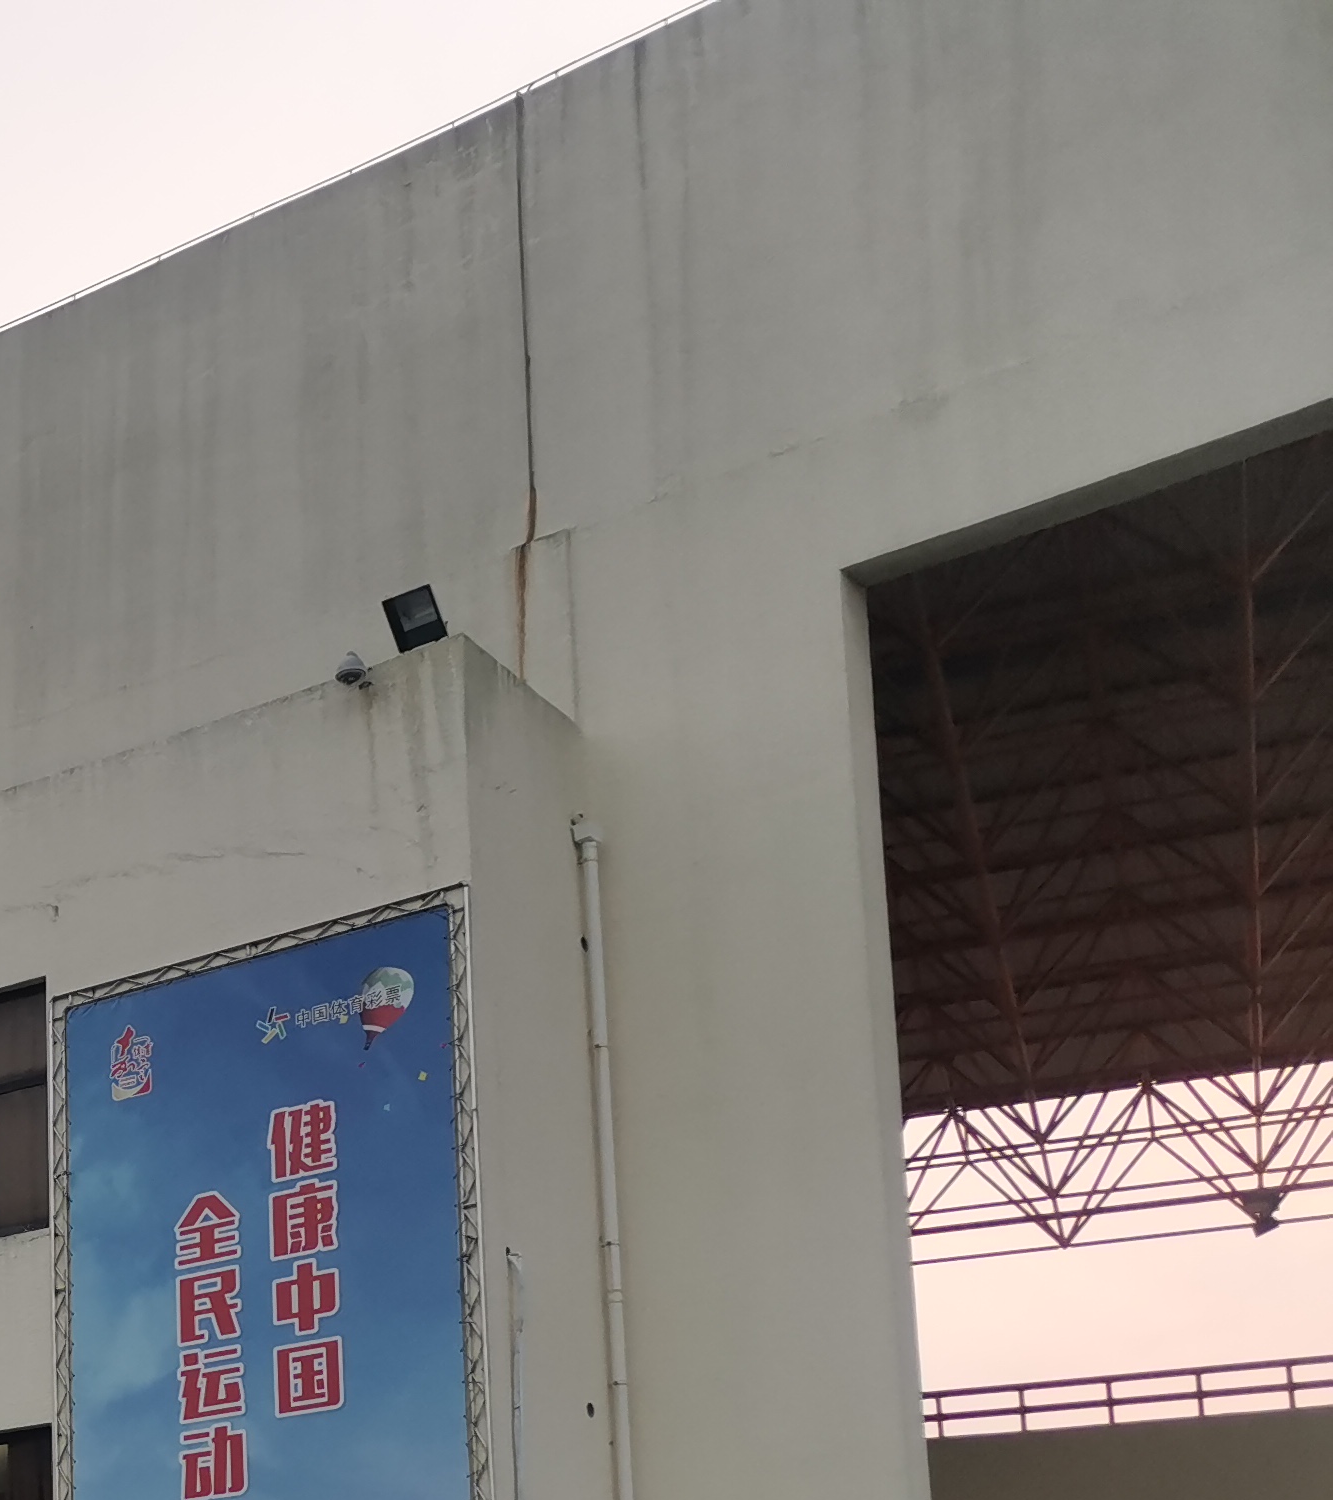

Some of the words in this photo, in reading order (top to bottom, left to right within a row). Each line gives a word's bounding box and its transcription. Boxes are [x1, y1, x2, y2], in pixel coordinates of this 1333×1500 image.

[295, 984, 402, 1028] 中国体育彩票
[267, 1099, 343, 1418] 健康中国
